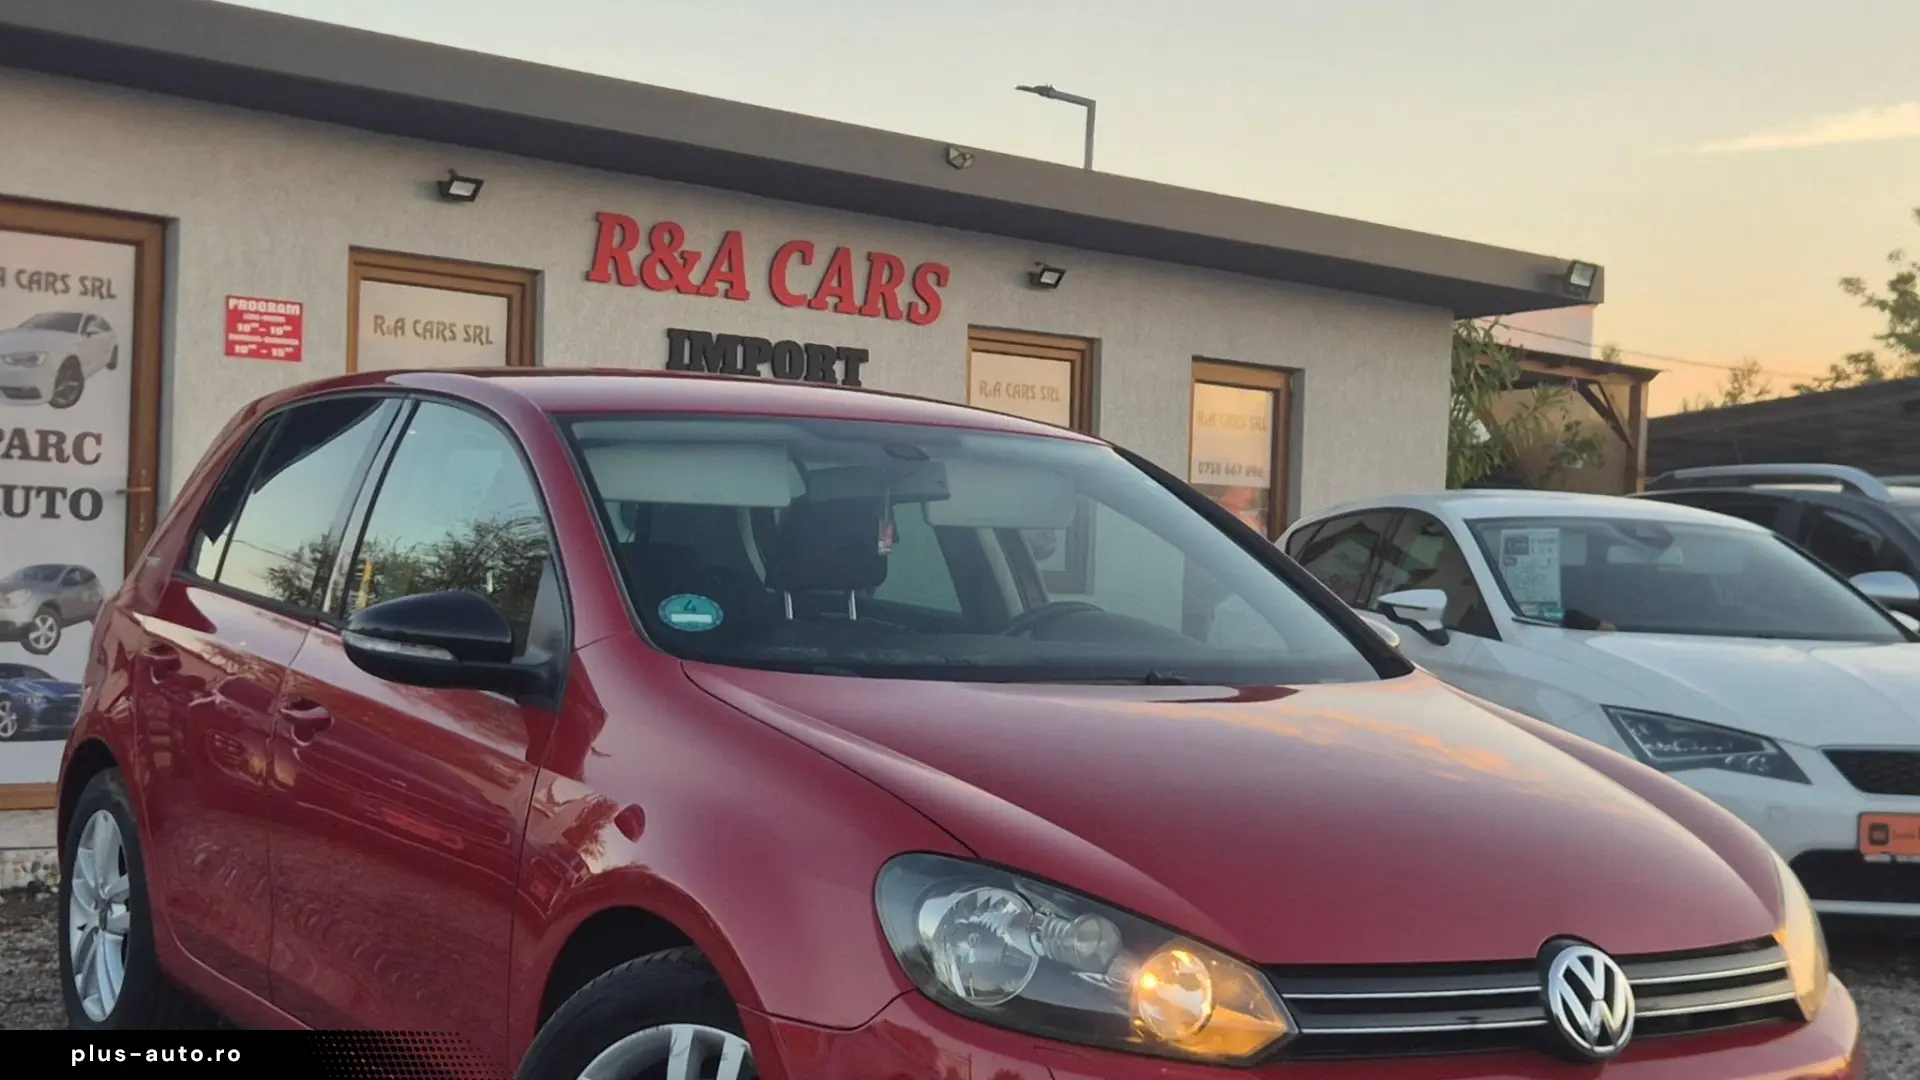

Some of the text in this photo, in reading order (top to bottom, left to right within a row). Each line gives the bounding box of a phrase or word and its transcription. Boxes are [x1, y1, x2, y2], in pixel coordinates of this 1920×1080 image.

[15, 268, 72, 296] CARS
[78, 274, 117, 300] SRL
[586, 212, 951, 325] R&A CARS
[229, 298, 300, 315] PROGRAM
[412, 319, 457, 342] CARS
[462, 324, 493, 346] SRL
[665, 327, 869, 386] IMPORT
[1005, 382, 1036, 401] CARS
[1040, 385, 1062, 403] SRL
[0, 427, 102, 466] ARC
[0, 484, 103, 522] UTO
[683, 599, 697, 612] 4
